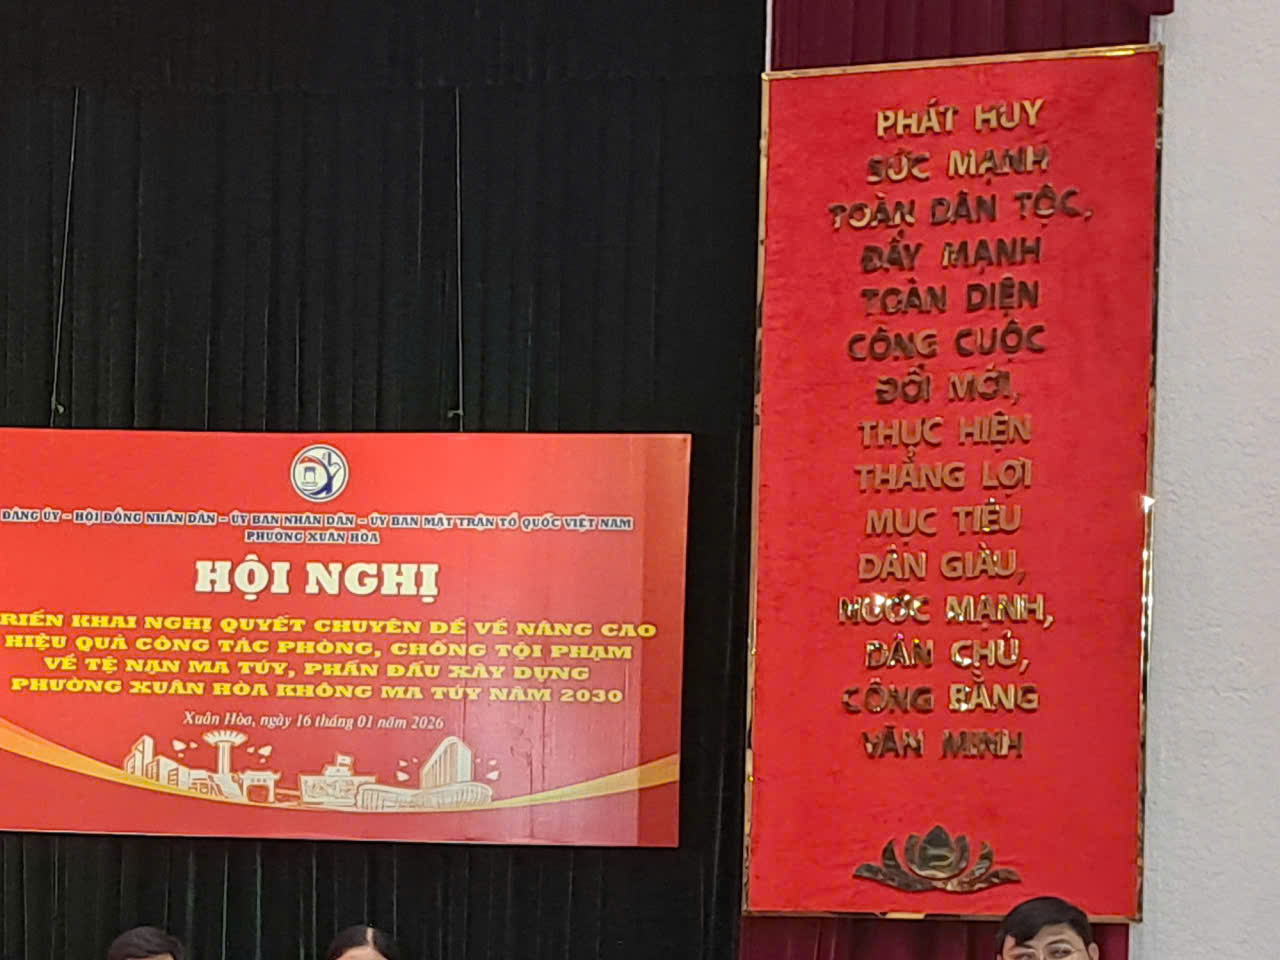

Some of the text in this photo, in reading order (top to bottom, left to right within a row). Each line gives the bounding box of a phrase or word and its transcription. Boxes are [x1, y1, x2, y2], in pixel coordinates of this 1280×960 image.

[876, 99, 1045, 137] PHÁT HUY
[866, 145, 1050, 186] SỨC MẠNH
[828, 183, 1095, 230] TOÀN DÂN TỘC,
[941, 236, 1043, 275] MẠNH
[861, 273, 1039, 317] TOÀN DIỆN
[847, 319, 1047, 363] CÔNG CUỘC
[858, 410, 1032, 453] THỰC HIỆN
[981, 458, 1032, 498] LỢI
[73, 509, 101, 526] HỘI
[145, 510, 185, 525] NHÂN
[251, 513, 280, 526] BAN
[283, 512, 322, 527] NHÂN
[390, 515, 421, 528] BAN
[521, 513, 561, 532] QUỐC
[563, 513, 597, 532] VIỆT
[598, 516, 634, 531] NAM
[306, 528, 347, 544] XUÂN
[865, 497, 1022, 546] MỤC TIÊU
[194, 553, 439, 603] HỘI NGHỊ
[858, 542, 1026, 584] DÂN GIÀU,
[71, 614, 137, 628] KHAI
[144, 616, 212, 632] NGHỊ
[220, 615, 306, 633] QUYẾT
[314, 617, 421, 633] CHUYÊN
[516, 620, 592, 637] NÂNG
[600, 623, 657, 638] CAO
[945, 594, 1056, 630] MẠNH,
[4, 632, 67, 652] HIỆU
[135, 635, 210, 652] CÔNG
[218, 637, 270, 653] TÁC
[277, 638, 382, 658] PHÒNG,
[390, 639, 487, 657] CHỐNG
[495, 641, 542, 660] TỘI
[551, 644, 633, 661] PHẠM
[864, 629, 1031, 672] DÂN CHỦ,
[84, 655, 118, 675] TỆ
[124, 659, 180, 675] NẠN
[187, 660, 230, 674] MA
[237, 659, 297, 679] TÚY,
[303, 659, 379, 677] PHẤN
[386, 660, 440, 678] ĐẤU
[447, 663, 506, 679] XÂY
[513, 666, 590, 683] DỰNG
[10, 675, 623, 703] PHƯỜNG XUÂN HÒA KHÔNG MA TÚY NĂM 2030
[842, 670, 1040, 714] CÔNG BẰNG
[183, 710, 444, 730] Xuân Hòa, ngày 16 tháng 01 năm 2026
[862, 726, 1024, 759] VĂN MINH
